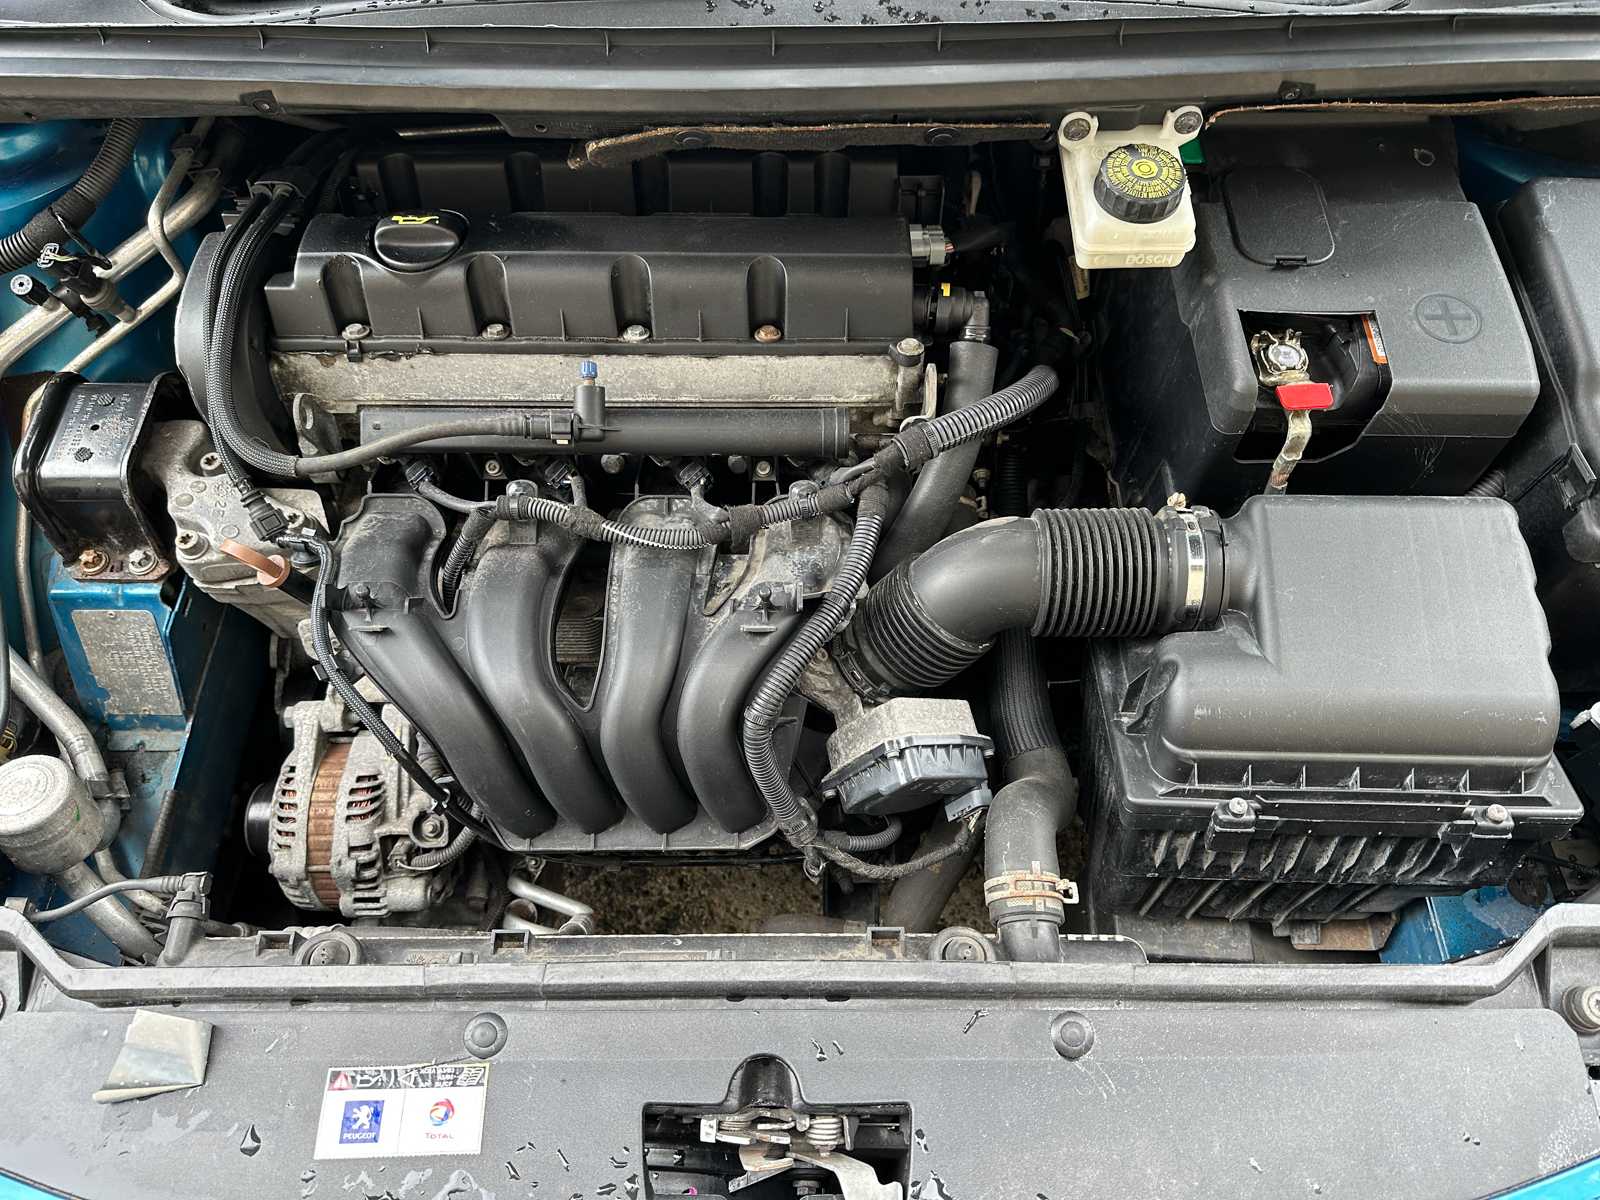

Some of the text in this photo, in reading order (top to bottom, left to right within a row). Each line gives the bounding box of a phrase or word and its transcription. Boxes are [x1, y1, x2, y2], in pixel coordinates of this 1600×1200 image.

[1125, 254, 1173, 265] BOSCH
[342, 1131, 377, 1141] PEUGEOT
[425, 1132, 454, 1140] TOTAL
